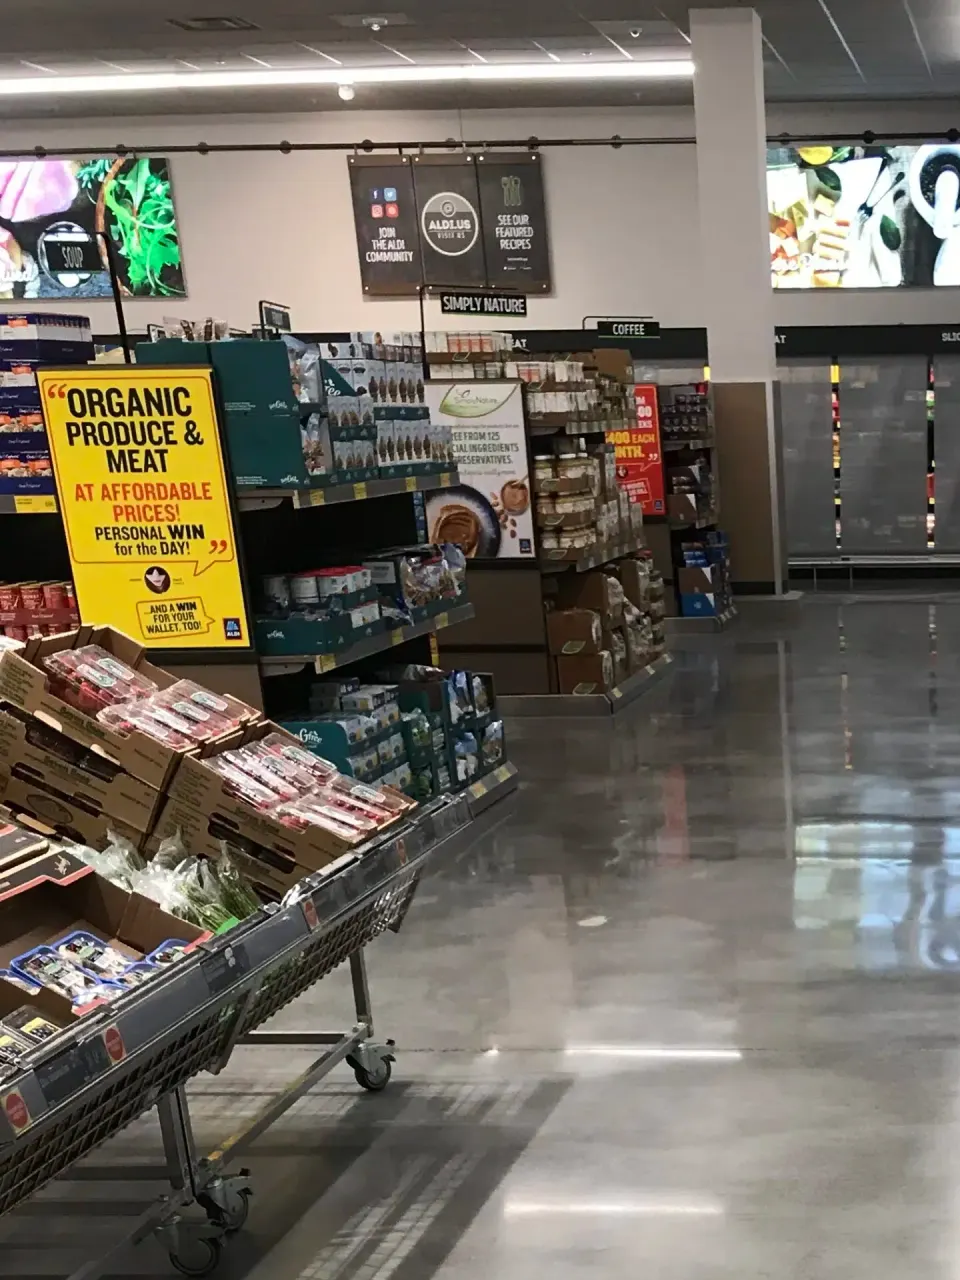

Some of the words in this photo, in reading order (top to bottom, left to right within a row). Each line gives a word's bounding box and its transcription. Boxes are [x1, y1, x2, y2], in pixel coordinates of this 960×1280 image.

[497, 215, 512, 226] SEE
[512, 215, 530, 226] OUR
[378, 227, 396, 239] JOIN
[495, 226, 534, 238] FEATURED
[371, 240, 388, 250] THE
[388, 240, 405, 251] ALDI
[499, 238, 532, 250] RECIPES
[61, 247, 83, 269] SOUP
[365, 251, 414, 263] COMMUNITY
[443, 296, 482, 312] SIMPLY
[483, 297, 525, 313] NATURE
[612, 323, 645, 336] COFFEE
[65, 421, 178, 447] PRODUCE
[183, 420, 204, 446] &
[631, 433, 656, 444] EACH
[468, 443, 520, 453] INGREDIENTS
[106, 449, 169, 474] MEAT
[75, 483, 95, 502] AT
[100, 482, 213, 501] AFFORDABLE
[112, 504, 181, 523] PRICES!
[95, 526, 167, 541] PERSONAL
[167, 524, 205, 540] WIN
[114, 542, 133, 556] for
[136, 542, 158, 555] the
[159, 541, 191, 556] DAY!
[169, 604, 176, 612] A
[176, 601, 197, 611] WIN
[153, 614, 171, 624] FOR
[171, 611, 195, 621] YOUR
